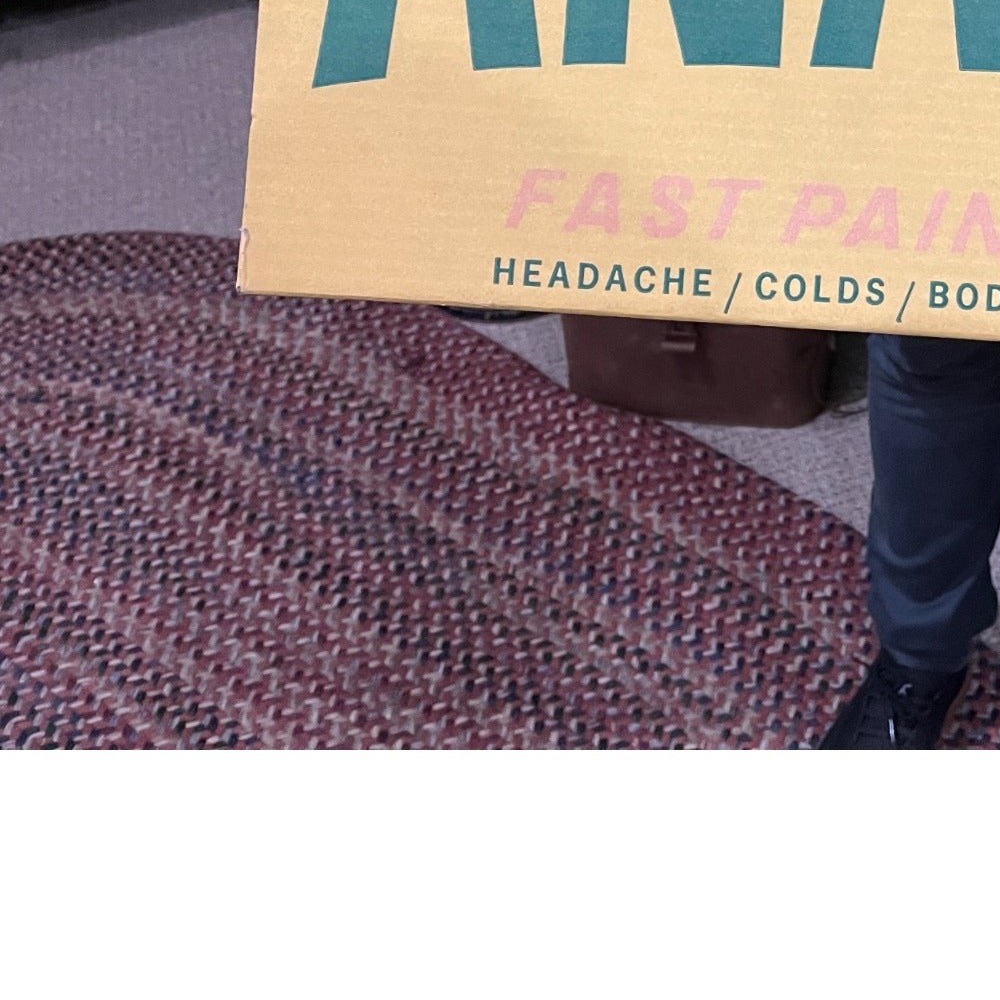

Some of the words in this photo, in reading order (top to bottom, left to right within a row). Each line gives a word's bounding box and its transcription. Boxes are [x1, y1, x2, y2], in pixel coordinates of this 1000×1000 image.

[504, 168, 763, 241] FAST
[492, 256, 713, 298] HEADACHE
[754, 270, 887, 307] COLDS
